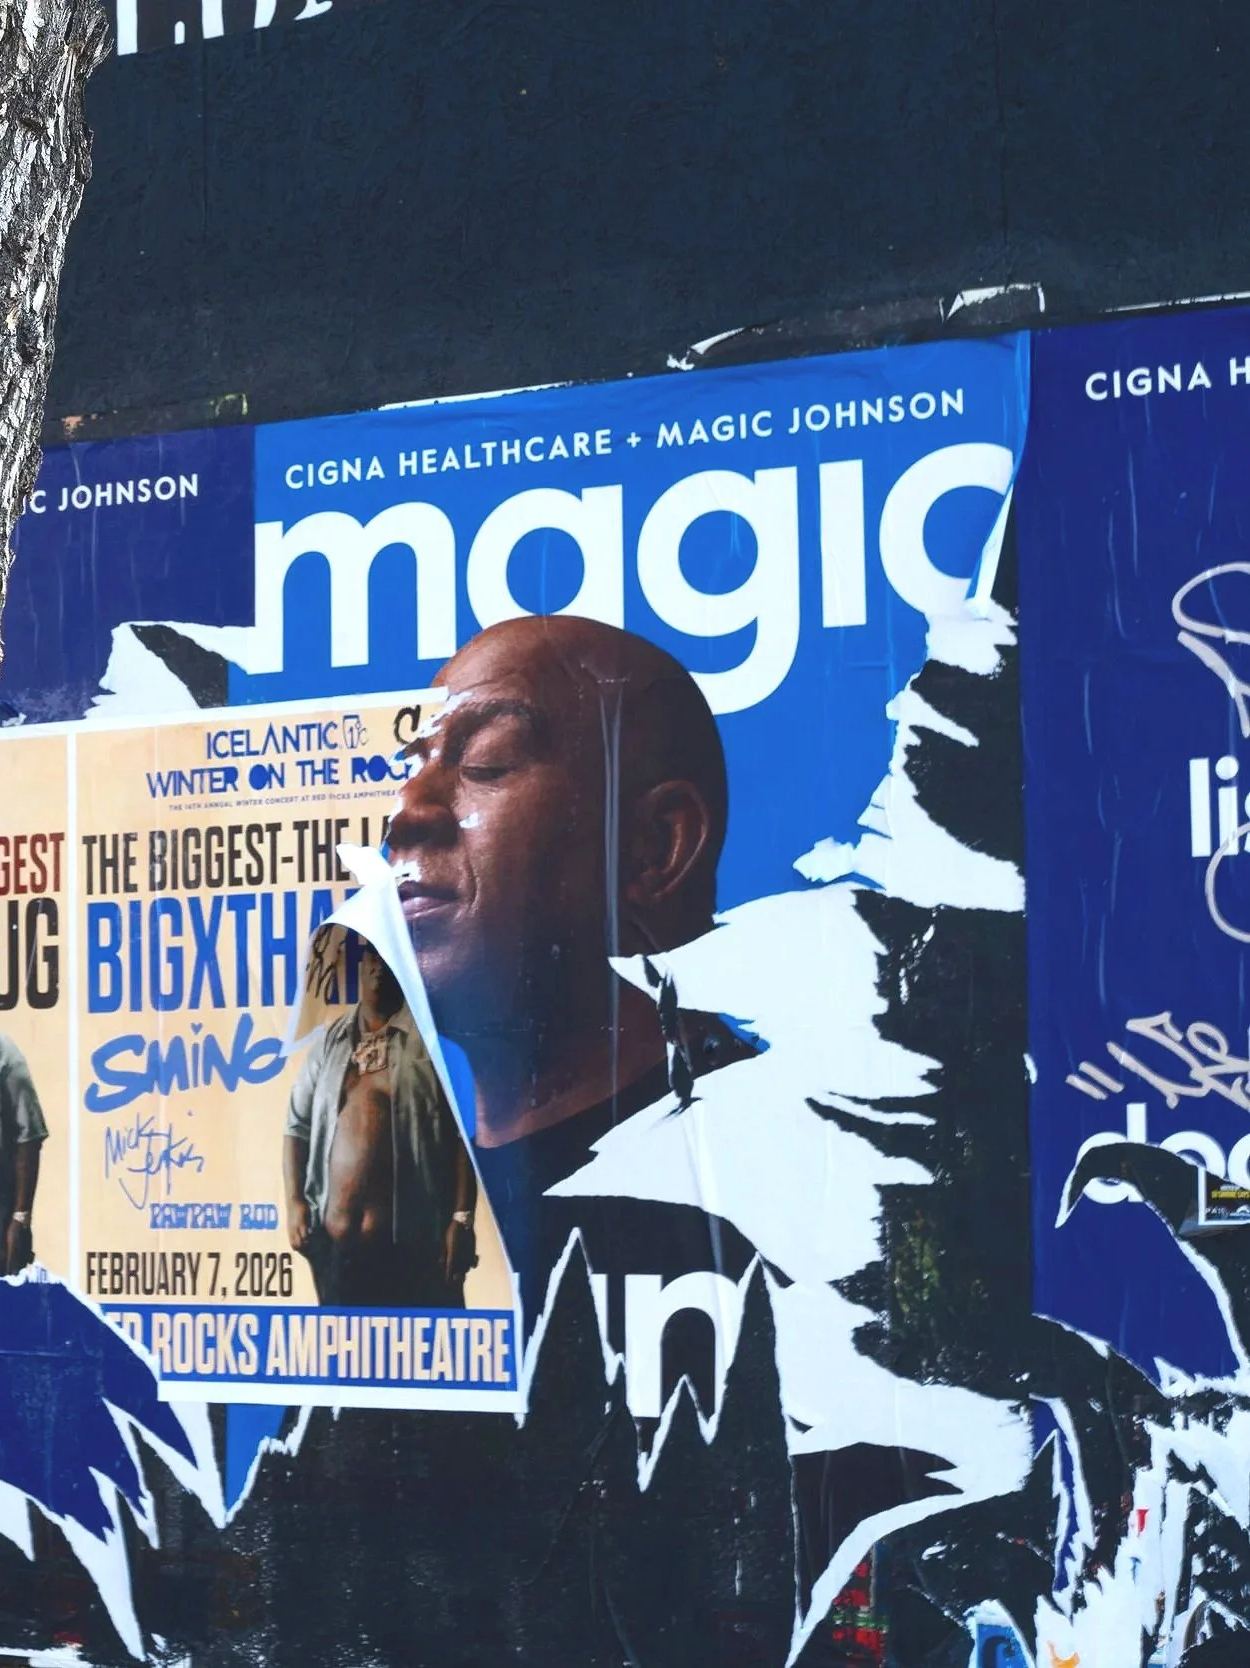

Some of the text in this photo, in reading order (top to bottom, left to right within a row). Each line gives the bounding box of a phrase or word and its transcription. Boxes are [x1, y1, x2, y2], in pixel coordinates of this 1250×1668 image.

[1085, 361, 1212, 401] CIGNA
[285, 456, 385, 489] CIGNA
[399, 429, 613, 476] HEALTHCARE
[656, 410, 773, 448] MAGIC
[788, 388, 965, 434] JOHNSON
[58, 473, 198, 512] JOHNSON
[206, 721, 338, 760] ICELANTIC
[146, 765, 239, 799] WINTER
[248, 761, 286, 791] ON
[296, 757, 340, 787] THE
[82, 833, 138, 895] THE
[150, 818, 350, 890] BIGGEST-THE
[86, 1251, 293, 1300] FEBRUARY 7, 2026
[151, 1311, 259, 1376] ROCKS
[266, 1313, 511, 1383] AMPHITHEATRE
